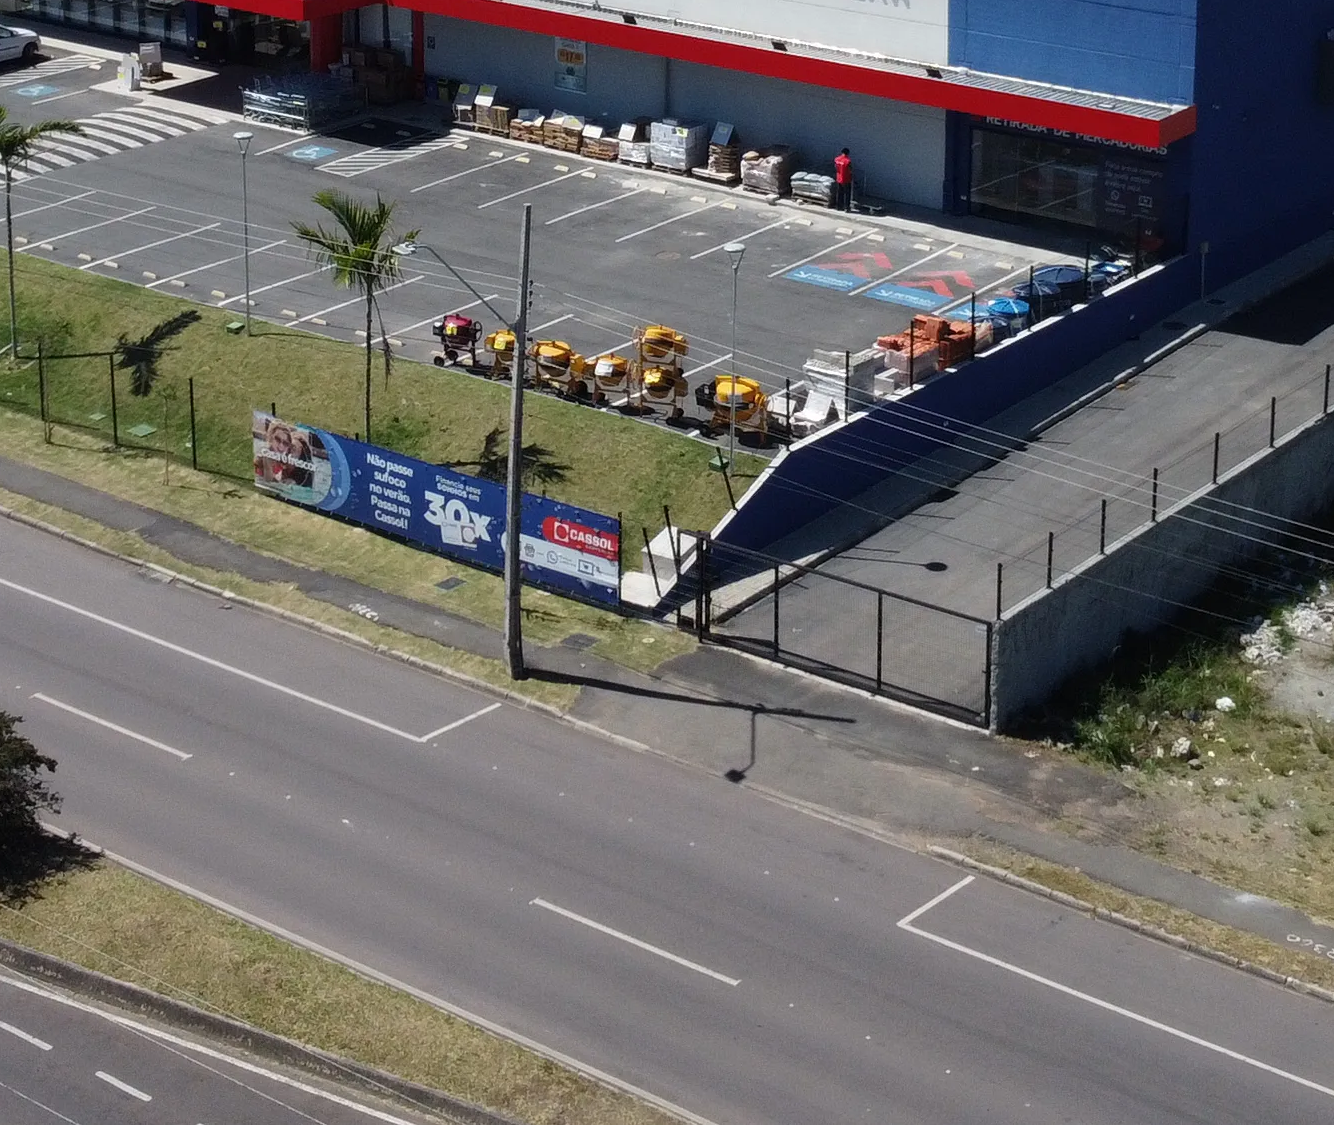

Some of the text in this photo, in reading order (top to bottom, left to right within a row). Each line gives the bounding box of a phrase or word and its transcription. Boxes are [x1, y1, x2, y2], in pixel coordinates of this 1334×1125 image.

[366, 452, 414, 478] Não passe
[369, 483, 382, 494] no
[373, 471, 406, 488] sufoco
[370, 495, 411, 517] Passa na
[423, 490, 492, 542] 30x
[374, 510, 408, 530] Cassol!
[569, 529, 614, 551] CASSOL
